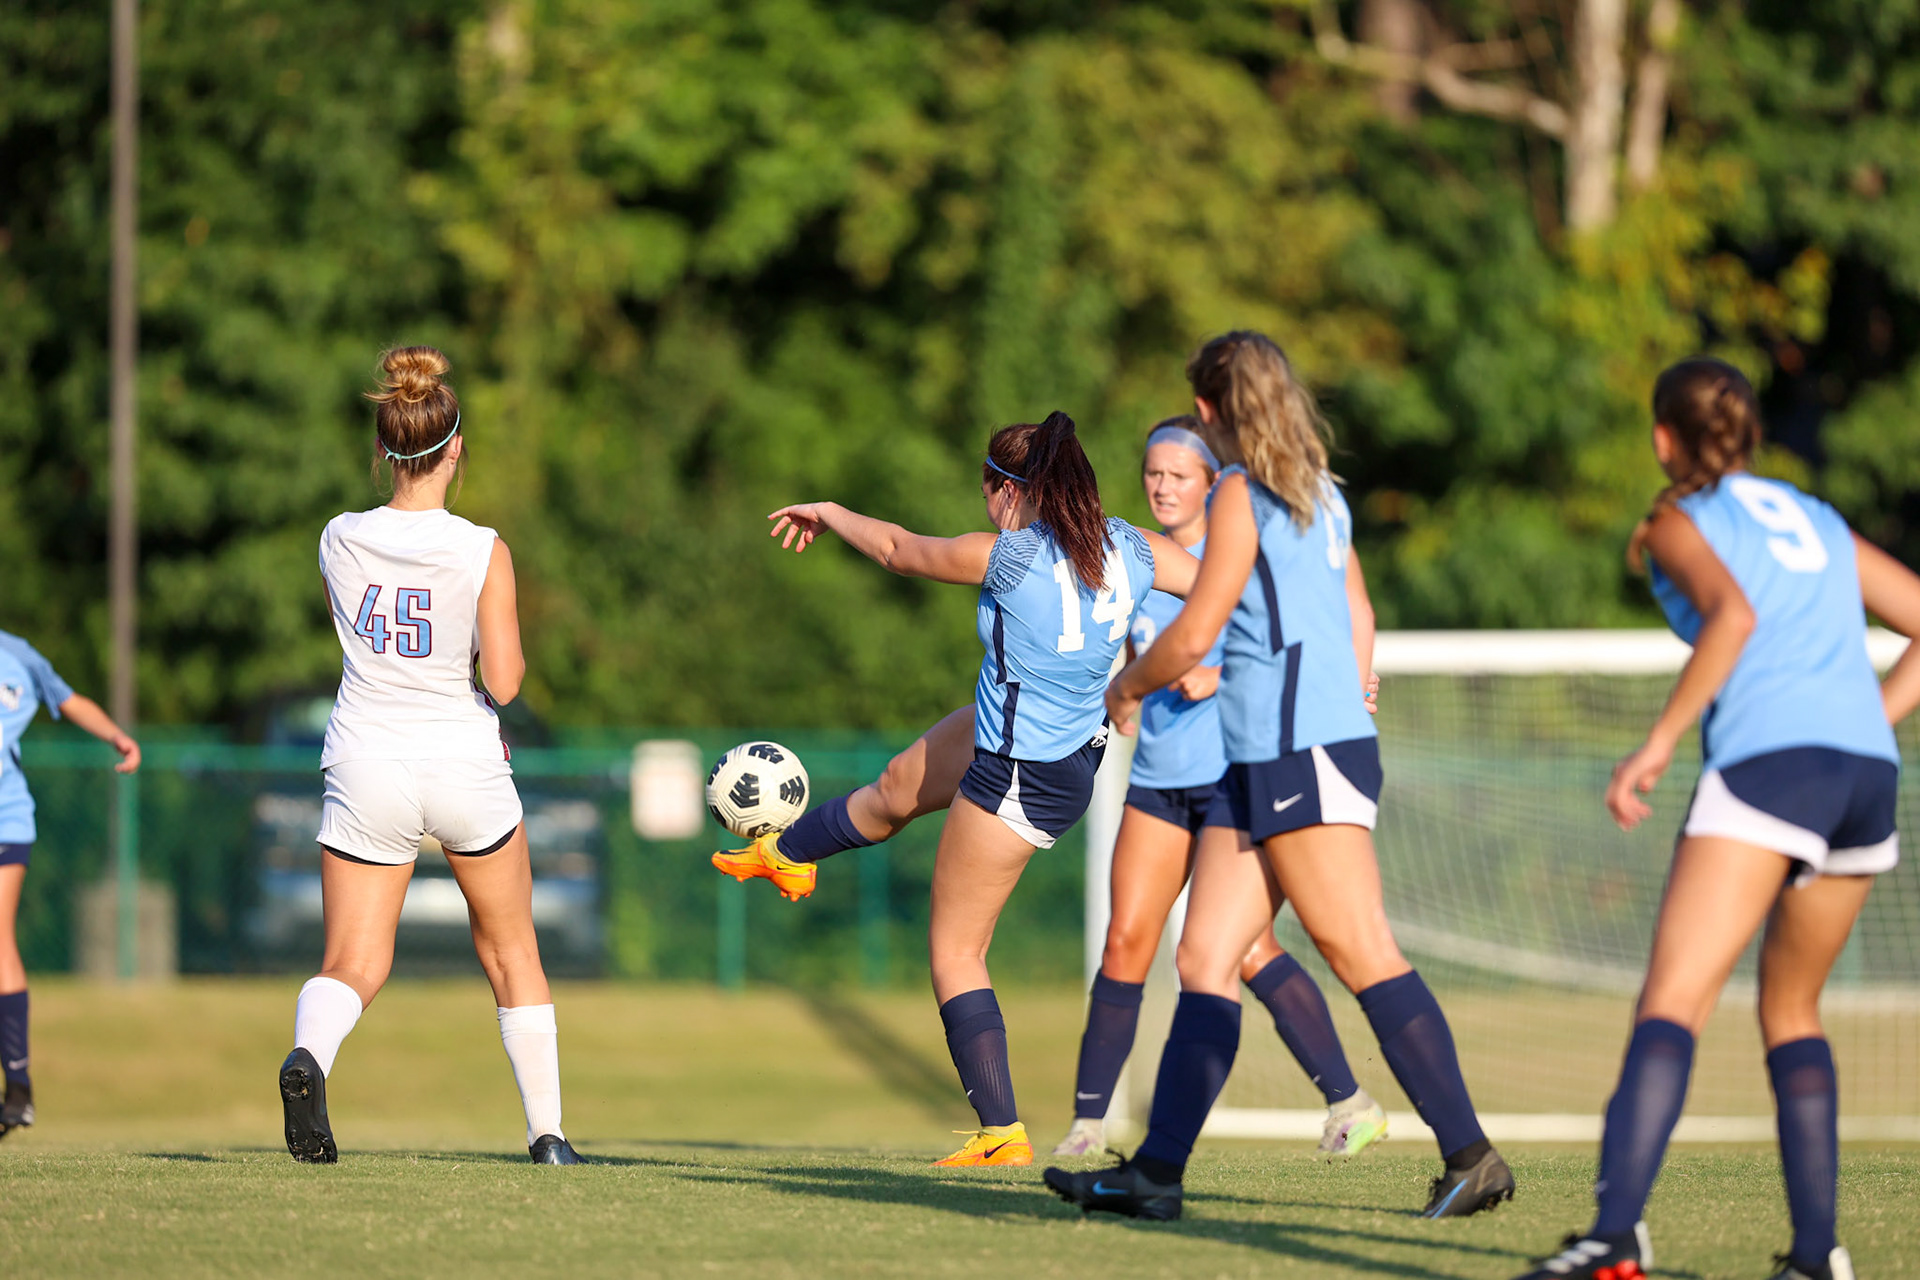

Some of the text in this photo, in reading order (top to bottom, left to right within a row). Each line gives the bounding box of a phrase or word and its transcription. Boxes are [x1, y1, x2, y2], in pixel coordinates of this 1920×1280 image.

[1730, 477, 1828, 573] 9
[354, 584, 431, 658] 45
[1053, 549, 1135, 652] 14
